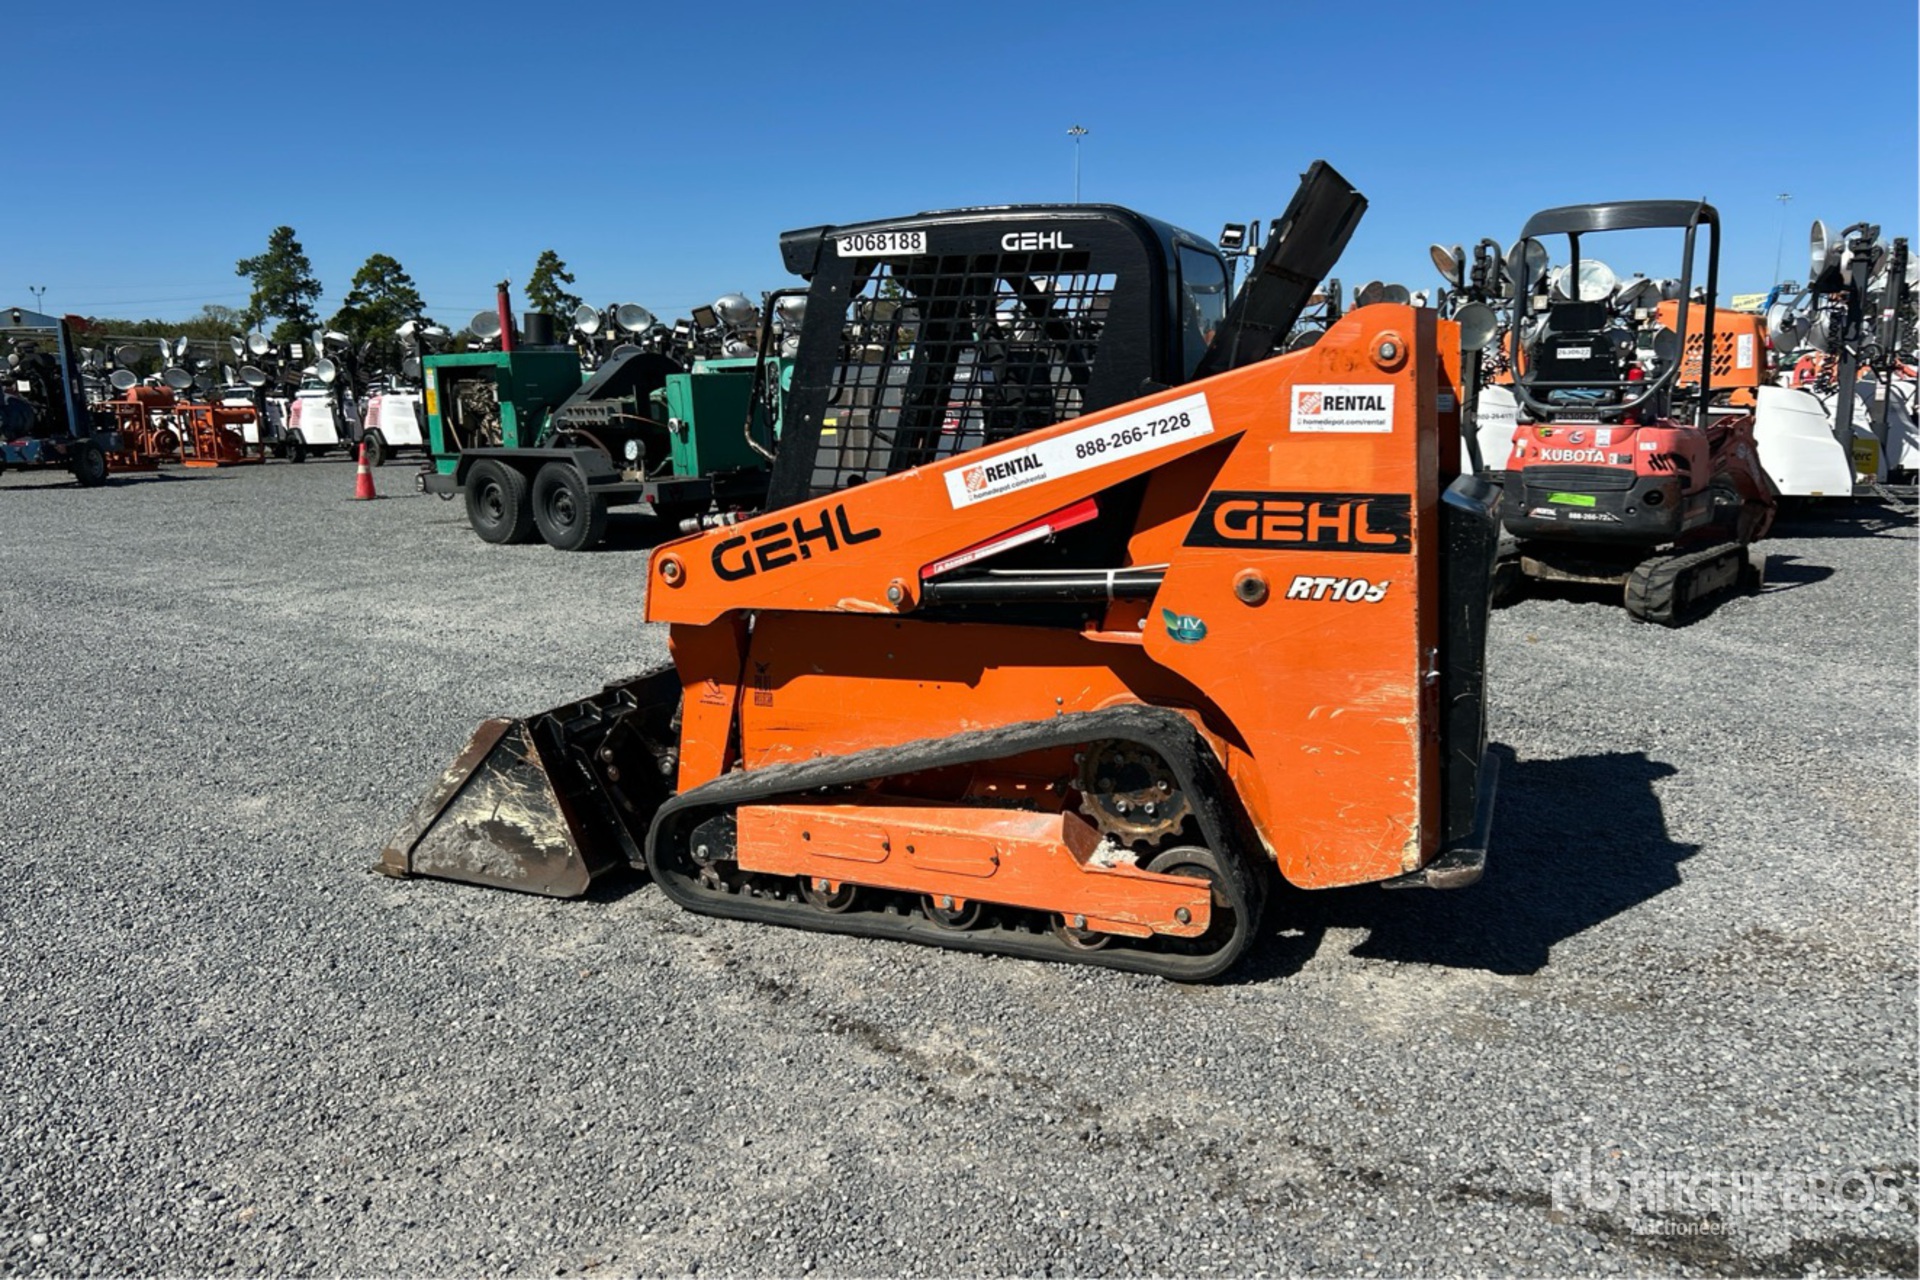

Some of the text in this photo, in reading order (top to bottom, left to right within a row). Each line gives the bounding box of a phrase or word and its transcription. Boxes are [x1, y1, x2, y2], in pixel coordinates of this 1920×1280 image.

[842, 233, 921, 252] 3068188
[1001, 231, 1073, 251] GEHL
[1323, 395, 1386, 411] RENTAL
[1303, 418, 1386, 427] homedepot.com/rental
[1076, 412, 1191, 460] 888-266-7228
[1540, 447, 1606, 464] KUBOTA
[985, 453, 1043, 483] RENTAL
[973, 472, 1047, 499] homedepot.com/rental
[1212, 499, 1397, 545] GEHL
[712, 504, 882, 582] GEHL
